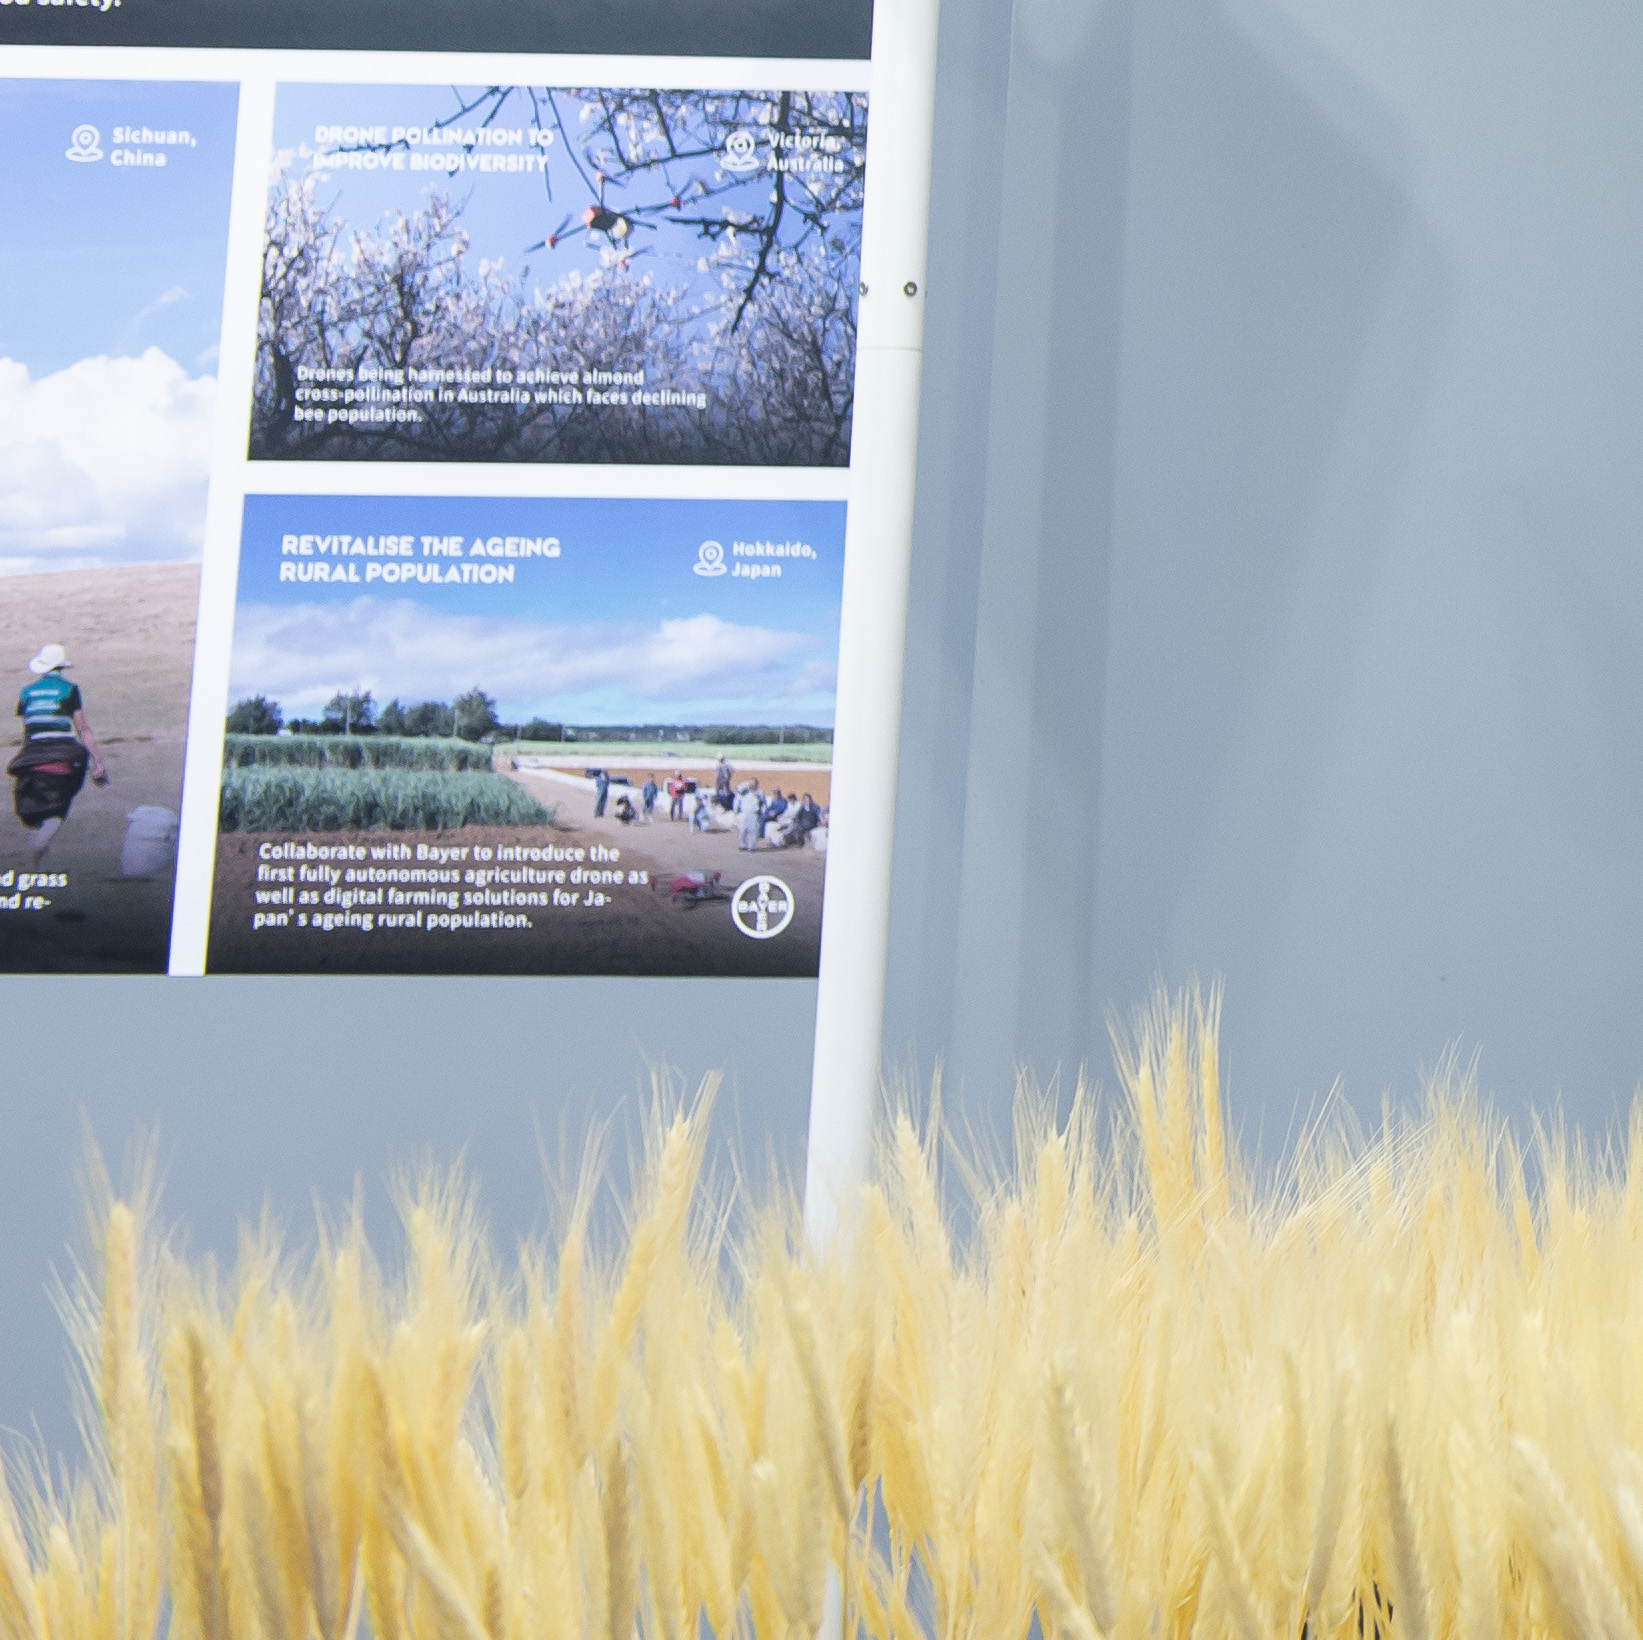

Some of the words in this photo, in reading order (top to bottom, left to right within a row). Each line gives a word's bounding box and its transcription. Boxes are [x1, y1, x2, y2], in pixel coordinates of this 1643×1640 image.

[112, 126, 197, 148] Sichuan,
[315, 125, 387, 144] DRONE
[391, 125, 523, 146] POLLINATION
[527, 128, 555, 148] TO
[110, 148, 168, 167] China
[312, 153, 405, 172] IMPROVE
[410, 153, 549, 174] BIODIVERSITY
[297, 364, 354, 382] Drones
[358, 365, 404, 386] being
[408, 365, 493, 383] harnessed
[496, 367, 514, 384] to
[516, 367, 580, 385] achieve
[583, 368, 645, 386] almond
[294, 386, 434, 405] cross-pollination
[438, 387, 455, 403] in
[456, 385, 531, 404] Australia
[534, 387, 583, 405] which
[586, 389, 629, 406] faces
[631, 389, 707, 410] declining
[293, 404, 325, 422] bee
[327, 407, 423, 425] population.
[281, 534, 415, 557] REVITALISE
[420, 535, 464, 558] THE
[469, 536, 561, 559] AGEING
[732, 540, 818, 561] Hokkaido,
[279, 561, 361, 584] RURAL
[365, 562, 516, 585] POPULATION
[731, 561, 782, 580] Japan
[258, 841, 368, 861] Collaborate
[370, 842, 413, 861] with
[416, 843, 470, 865] Bayer
[473, 845, 494, 862] to
[496, 844, 587, 863] introduce
[589, 844, 621, 863] the
[16, 873, 68, 892] grass
[257, 863, 296, 883] first
[298, 863, 342, 887] fully
[344, 866, 461, 884] autonomous
[464, 865, 566, 888] agriculture
[569, 866, 625, 885] drone
[628, 869, 650, 885] as
[254, 886, 295, 906] well
[297, 889, 321, 906] as
[323, 887, 385, 909] digital
[387, 886, 460, 910] farming
[463, 888, 549, 907] solutions
[552, 888, 580, 907] for
[583, 889, 613, 907] Ja-
[311, 909, 374, 932] ageing
[377, 910, 424, 929] rural
[426, 910, 534, 932] population.
